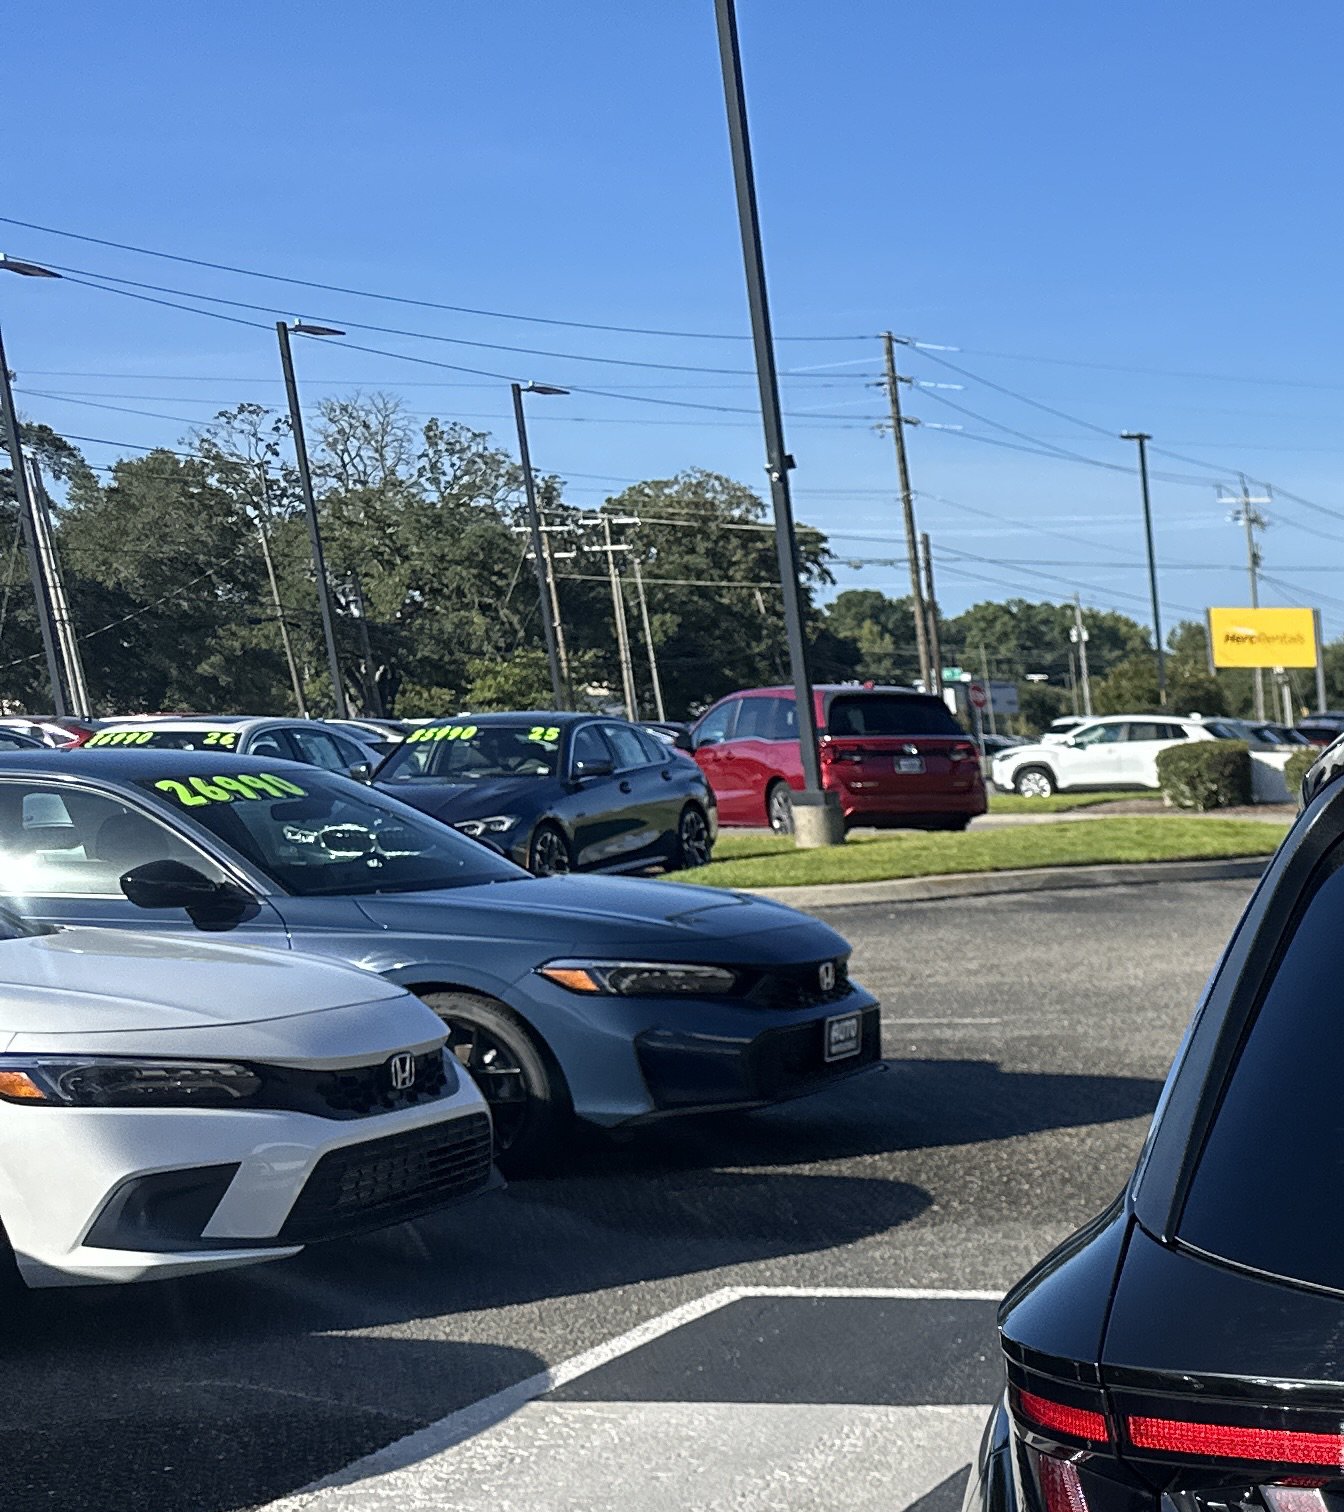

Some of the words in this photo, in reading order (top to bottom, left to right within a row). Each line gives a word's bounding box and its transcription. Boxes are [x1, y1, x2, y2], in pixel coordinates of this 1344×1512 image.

[203, 732, 235, 745] 26
[528, 726, 560, 741] 25
[155, 773, 308, 806] 26990
